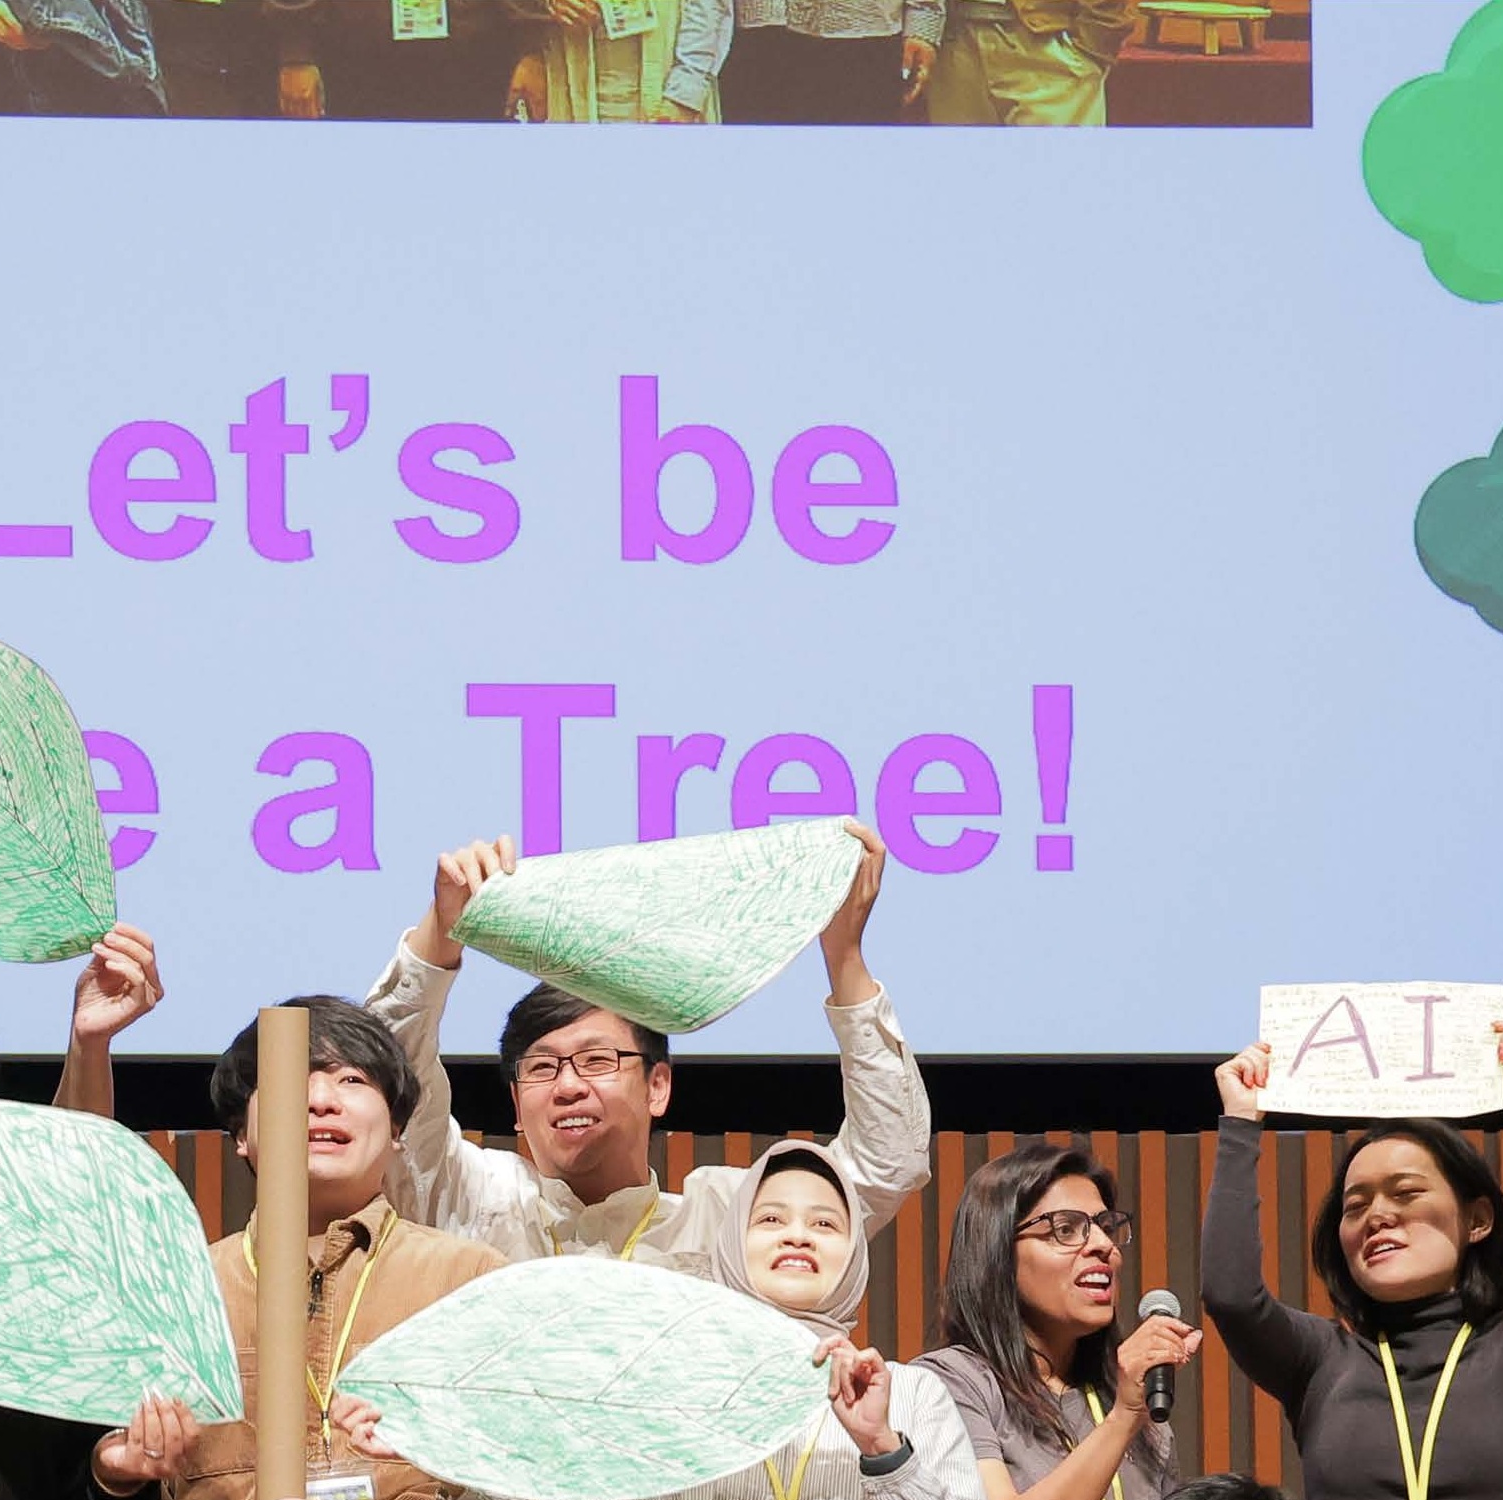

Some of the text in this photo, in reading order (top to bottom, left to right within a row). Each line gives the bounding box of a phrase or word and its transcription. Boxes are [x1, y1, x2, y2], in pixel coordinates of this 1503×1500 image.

[620, 375, 898, 565] be
[251, 732, 380, 873] a
[466, 683, 1073, 874] Tree!
[1287, 994, 1455, 1081] AI
